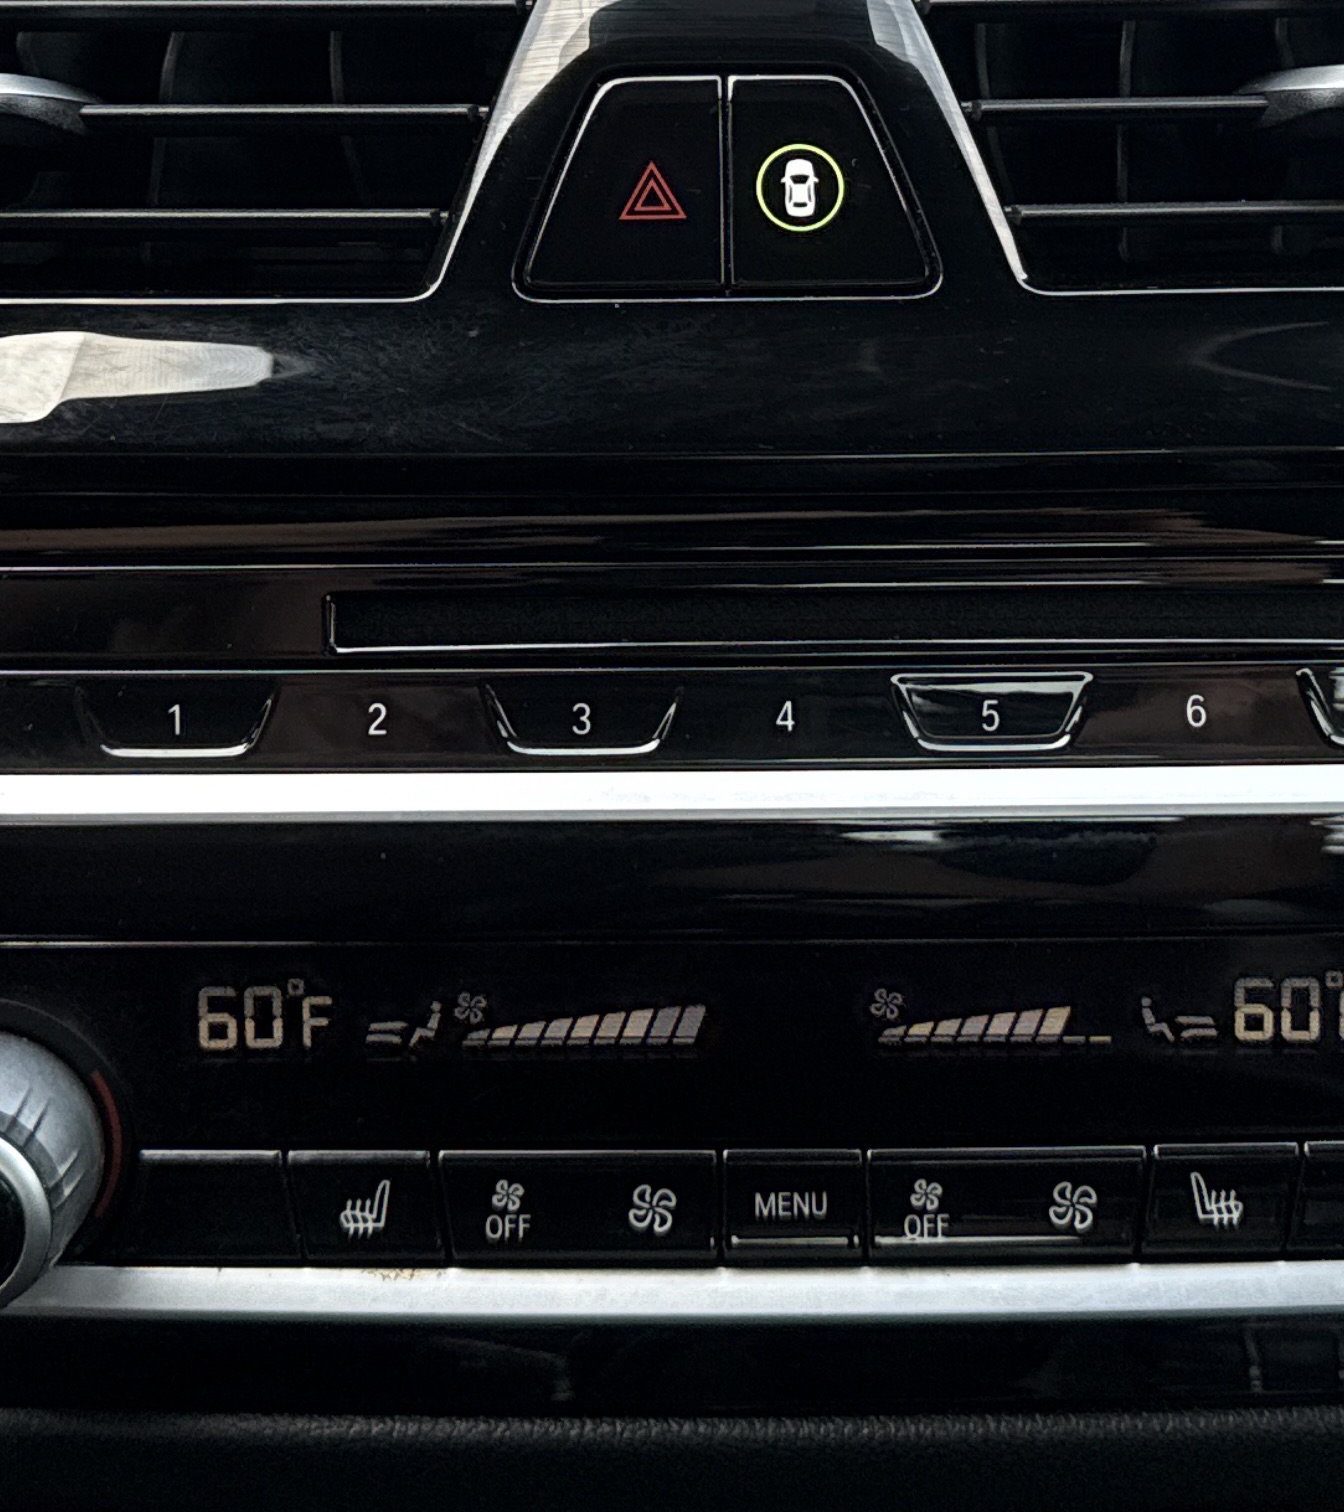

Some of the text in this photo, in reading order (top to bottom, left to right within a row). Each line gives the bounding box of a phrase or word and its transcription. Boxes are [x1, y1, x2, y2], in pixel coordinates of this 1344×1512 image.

[167, 704, 182, 736] 1
[367, 702, 388, 736] 2
[571, 702, 591, 736] 3
[775, 700, 796, 732] 4
[981, 699, 1000, 731] 5
[1186, 695, 1207, 727] 6
[754, 1191, 829, 1219] MENU
[485, 1214, 532, 1241] OFF
[903, 1213, 950, 1240] OFF
